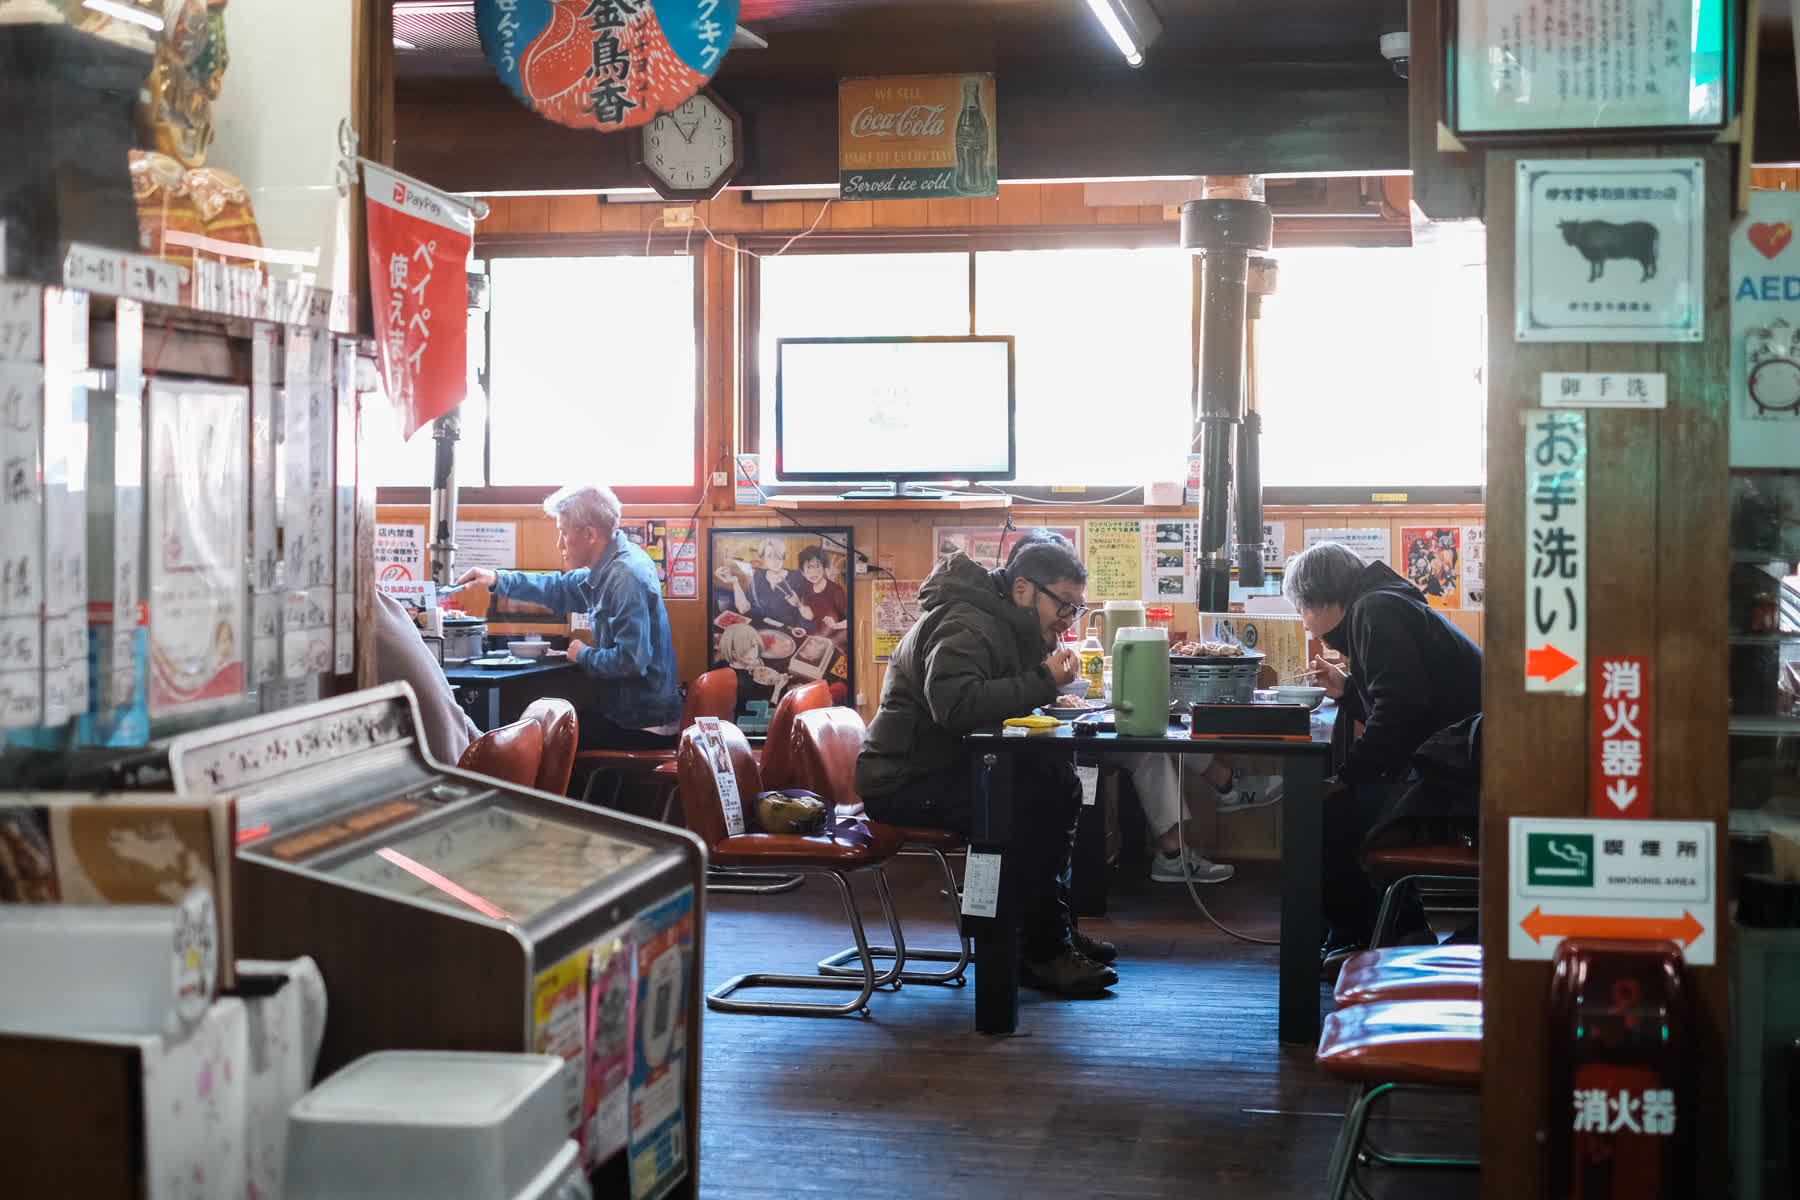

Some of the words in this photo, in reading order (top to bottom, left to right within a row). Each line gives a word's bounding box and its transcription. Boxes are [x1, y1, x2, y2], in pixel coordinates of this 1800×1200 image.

[714, 118, 722, 130] 2
[651, 135, 660, 148] 9
[719, 134, 727, 148] 3
[655, 153, 664, 167] 8
[686, 170, 695, 183] 6
[703, 165, 712, 179] 5
[844, 174, 897, 193] Served
[898, 176, 917, 191] ice
[920, 172, 952, 190] cold
[405, 191, 442, 216] PayPay
[1735, 275, 1800, 301] AED
[409, 240, 437, 374] ペイペイ
[1560, 377, 1649, 397] 御手洗
[1532, 412, 1579, 636] お手洗い
[1601, 660, 1642, 777] 消火器
[1603, 839, 1697, 858] 喫煙所
[1607, 875, 1661, 885] SMOKING
[1665, 877, 1697, 886] AREA
[1573, 1088, 1677, 1136] 消火器
